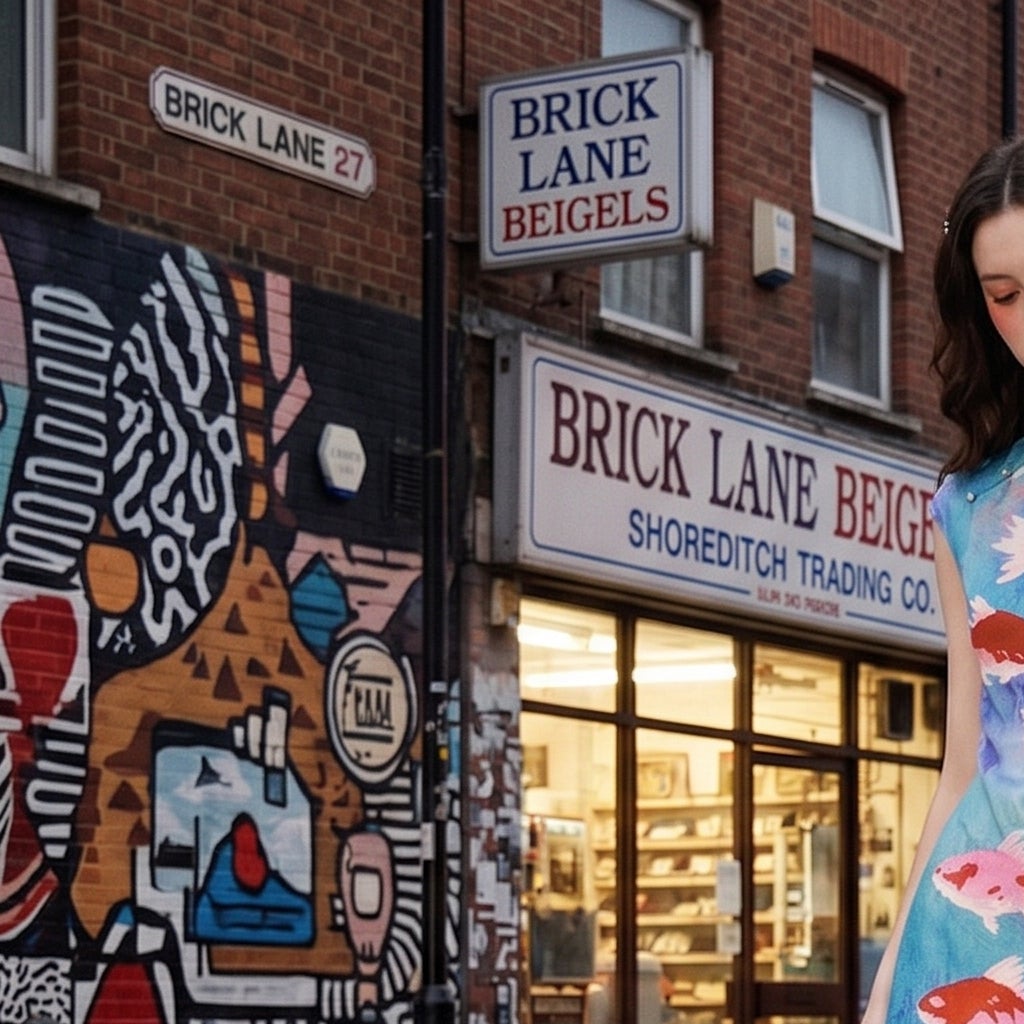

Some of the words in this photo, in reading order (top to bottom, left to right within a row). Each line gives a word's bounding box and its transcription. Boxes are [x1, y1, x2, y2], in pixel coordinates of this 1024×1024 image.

[165, 83, 246, 142] BRICK
[257, 116, 325, 170] LANE
[334, 145, 364, 181] 27
[510, 77, 659, 141] BRICK
[519, 134, 651, 193] LANE
[502, 185, 670, 243] BEIGELS
[550, 381, 691, 498] BRICK
[709, 428, 819, 531] LANE
[628, 509, 787, 582] SHOREDITCH
[798, 550, 892, 605] TRADING
[901, 576, 936, 615] CO.
